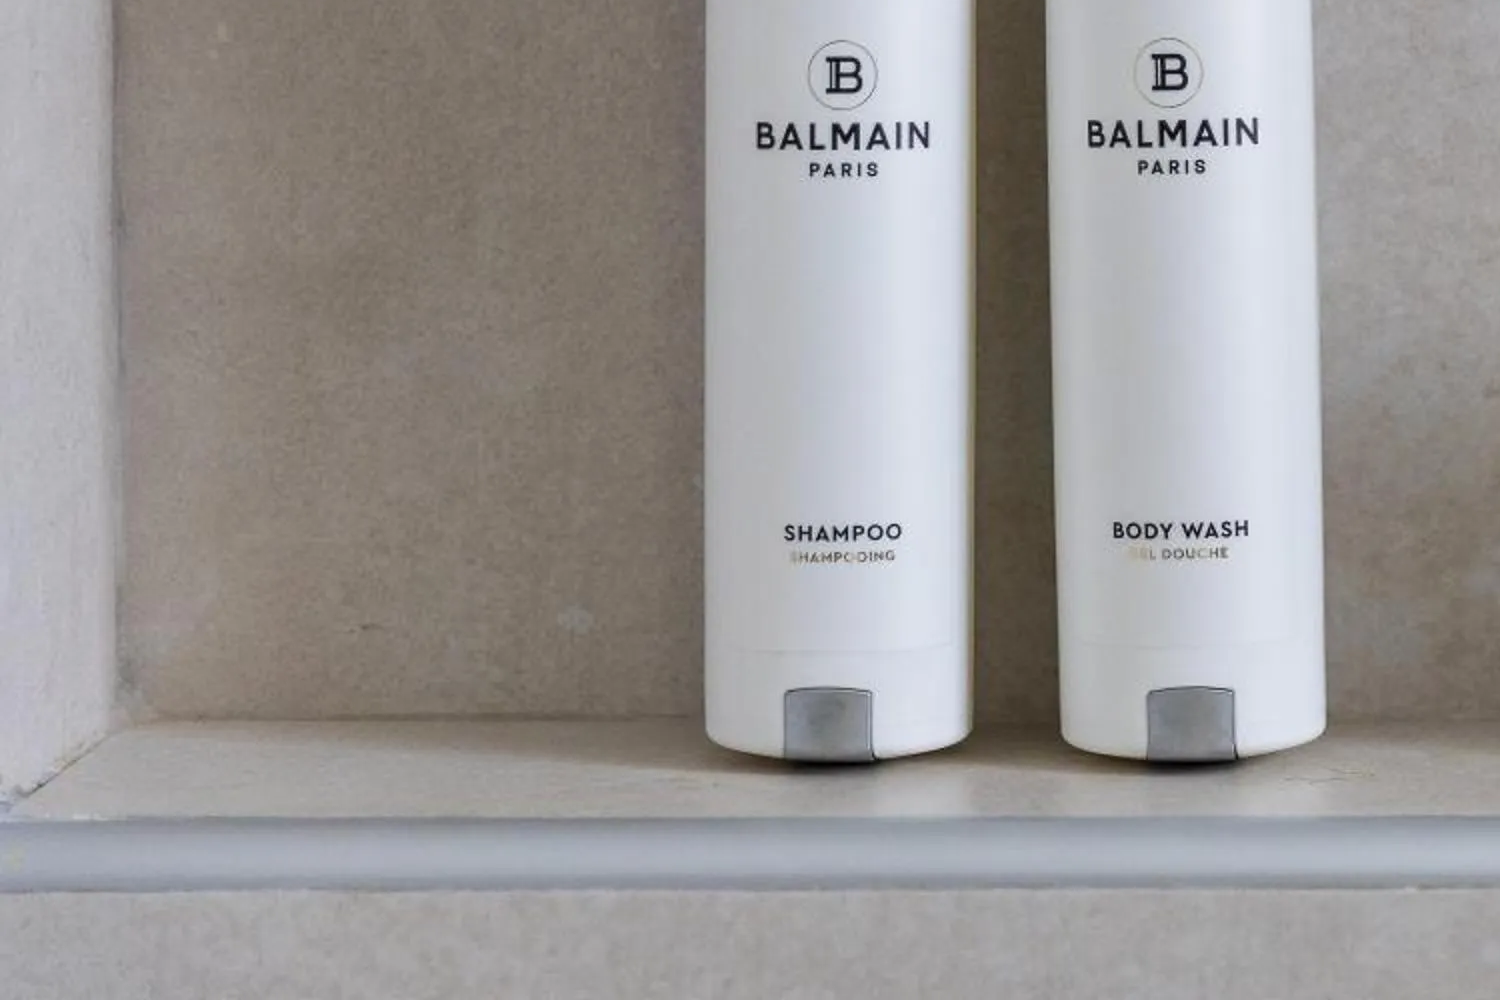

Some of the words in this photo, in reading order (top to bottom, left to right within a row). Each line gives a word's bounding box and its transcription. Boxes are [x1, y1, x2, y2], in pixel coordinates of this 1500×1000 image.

[825, 55, 864, 95] B
[1151, 53, 1189, 92] B
[755, 121, 930, 151] BALMAIN
[1087, 117, 1259, 148] BALMAIN
[809, 162, 879, 178] PARIS
[1137, 158, 1206, 175] PARIS
[784, 523, 903, 543] SHAMPOO
[1112, 520, 1174, 540] BODY
[1181, 519, 1249, 539] WASH
[790, 549, 895, 564] HAMPOOING
[1161, 546, 1229, 561] DOUCHE
